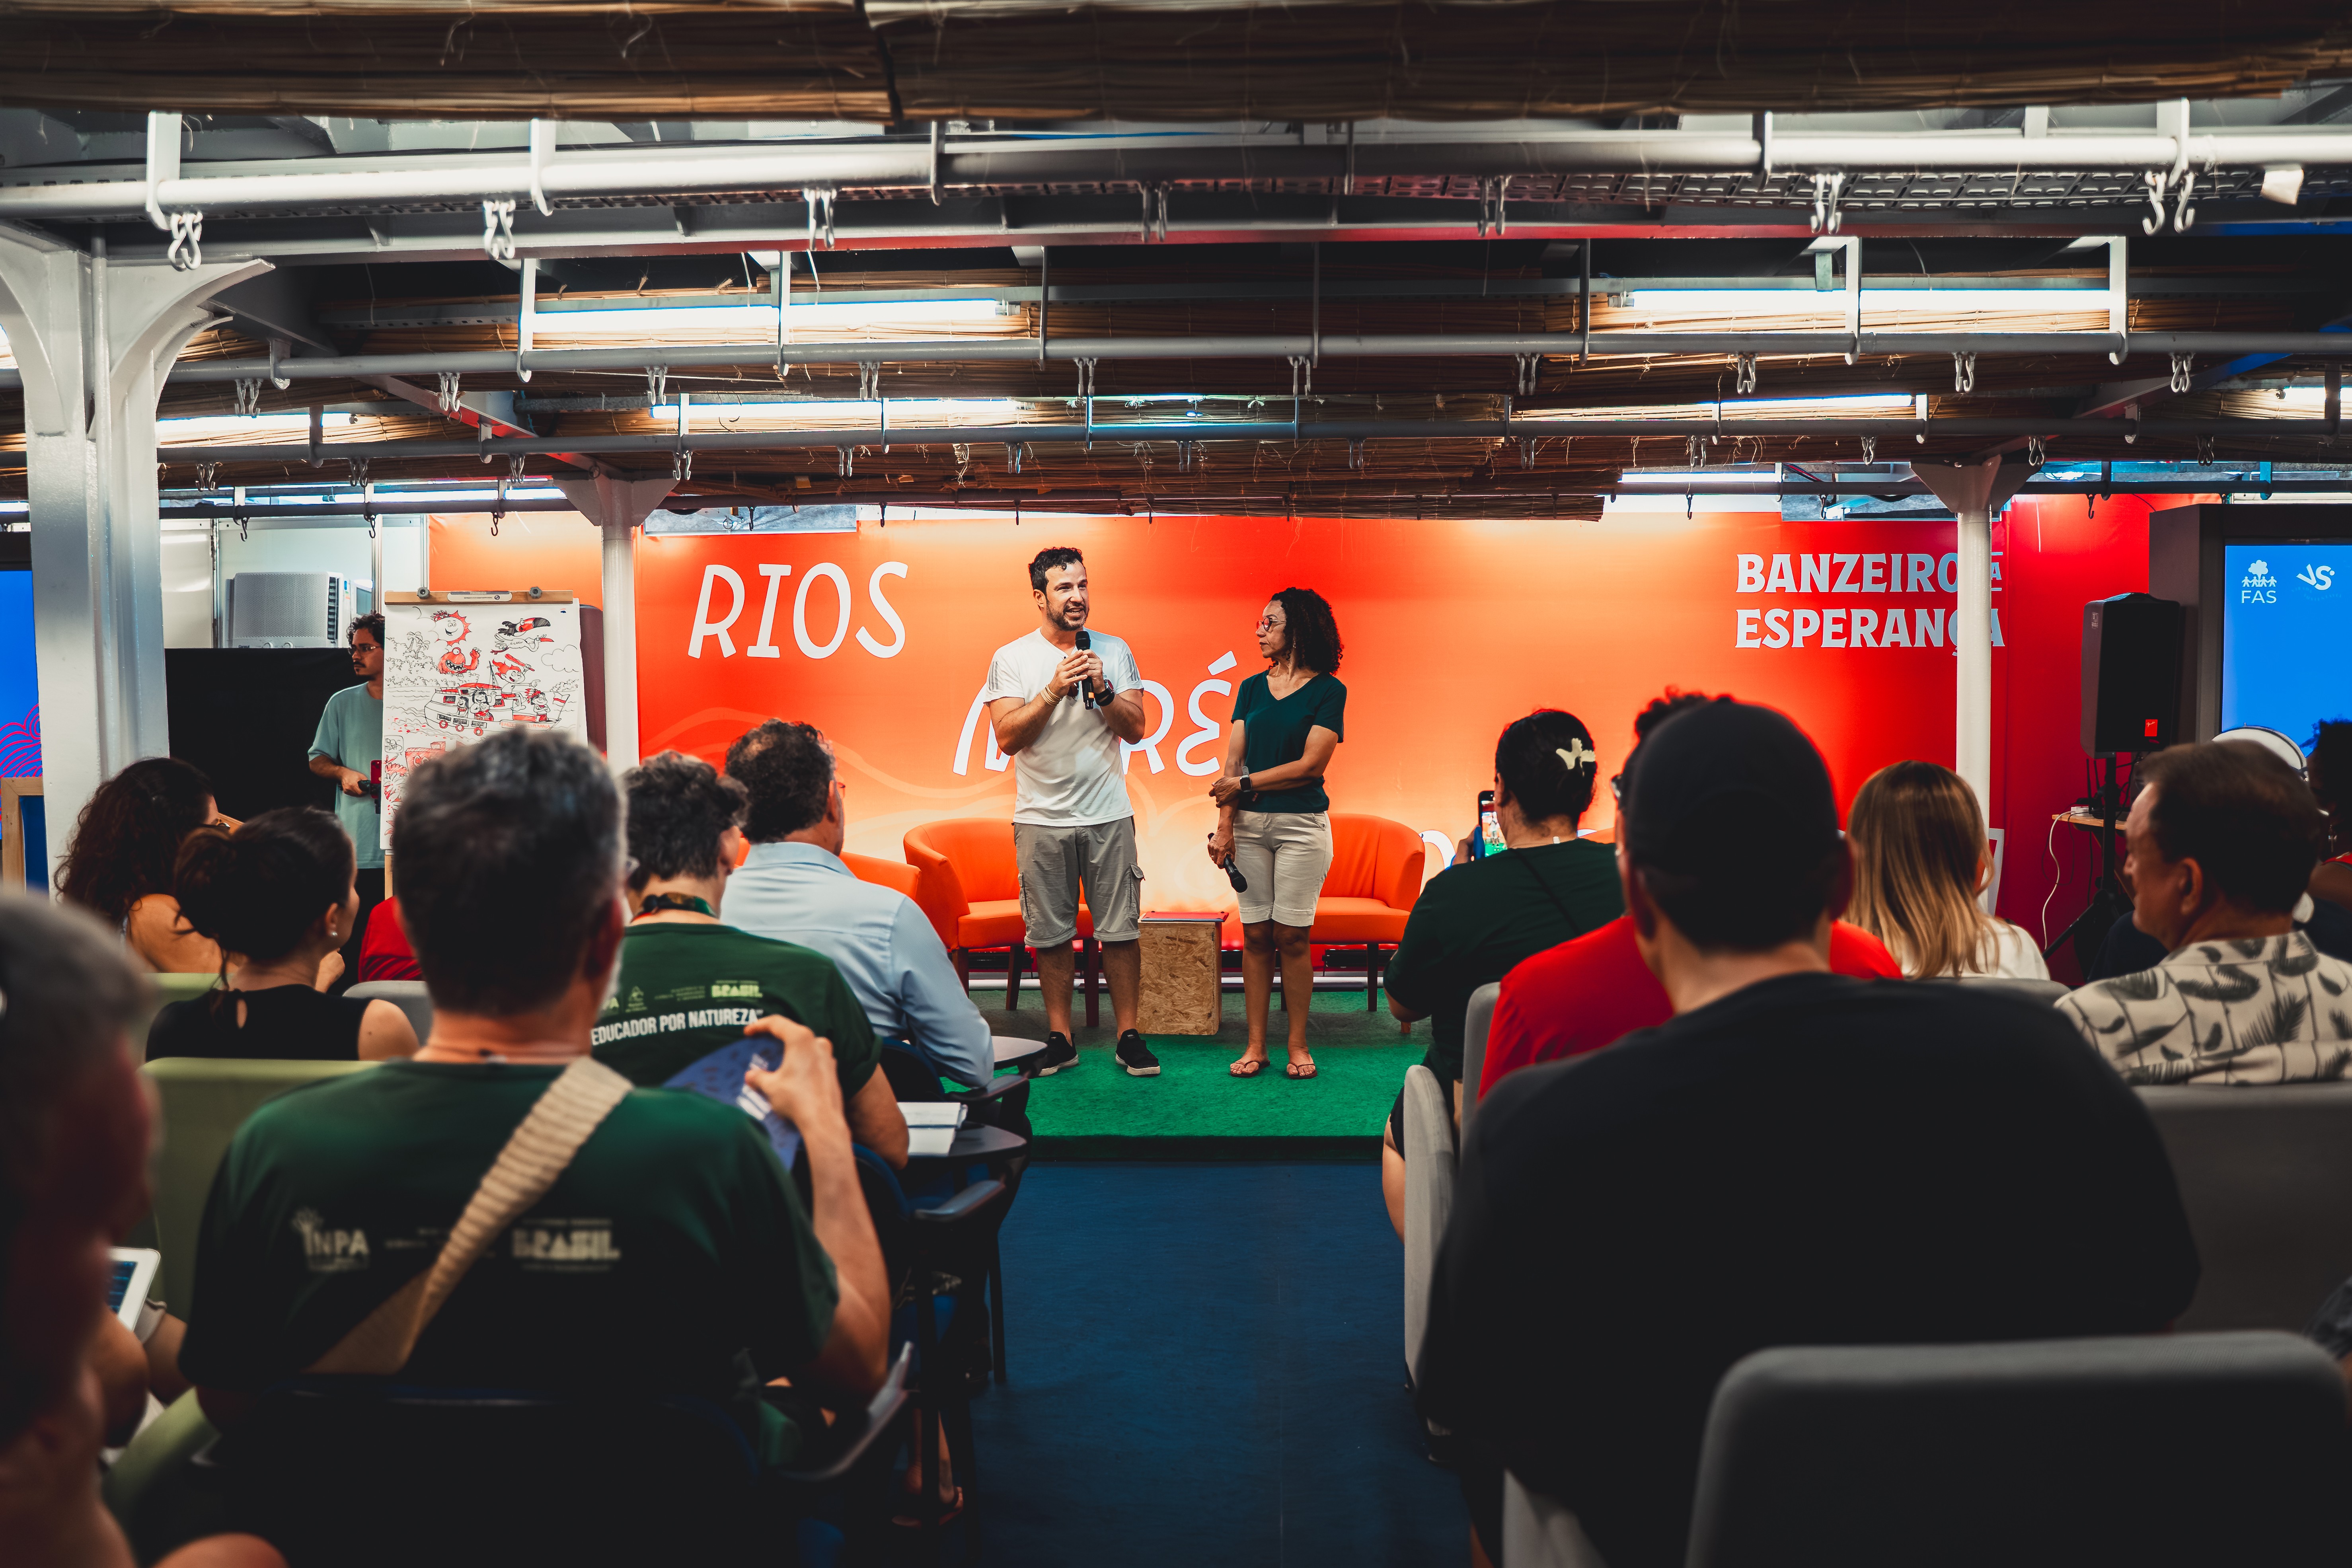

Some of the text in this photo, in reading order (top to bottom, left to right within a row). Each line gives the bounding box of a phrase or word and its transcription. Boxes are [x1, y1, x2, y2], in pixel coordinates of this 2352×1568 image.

[1736, 553, 1958, 593] BANZEIRO
[688, 561, 908, 659] RIOS
[2241, 590, 2277, 604] FAS
[953, 651, 1237, 776] MRÉ
[591, 1016, 657, 1046] EDUCADOR
[659, 1012, 686, 1032] POR
